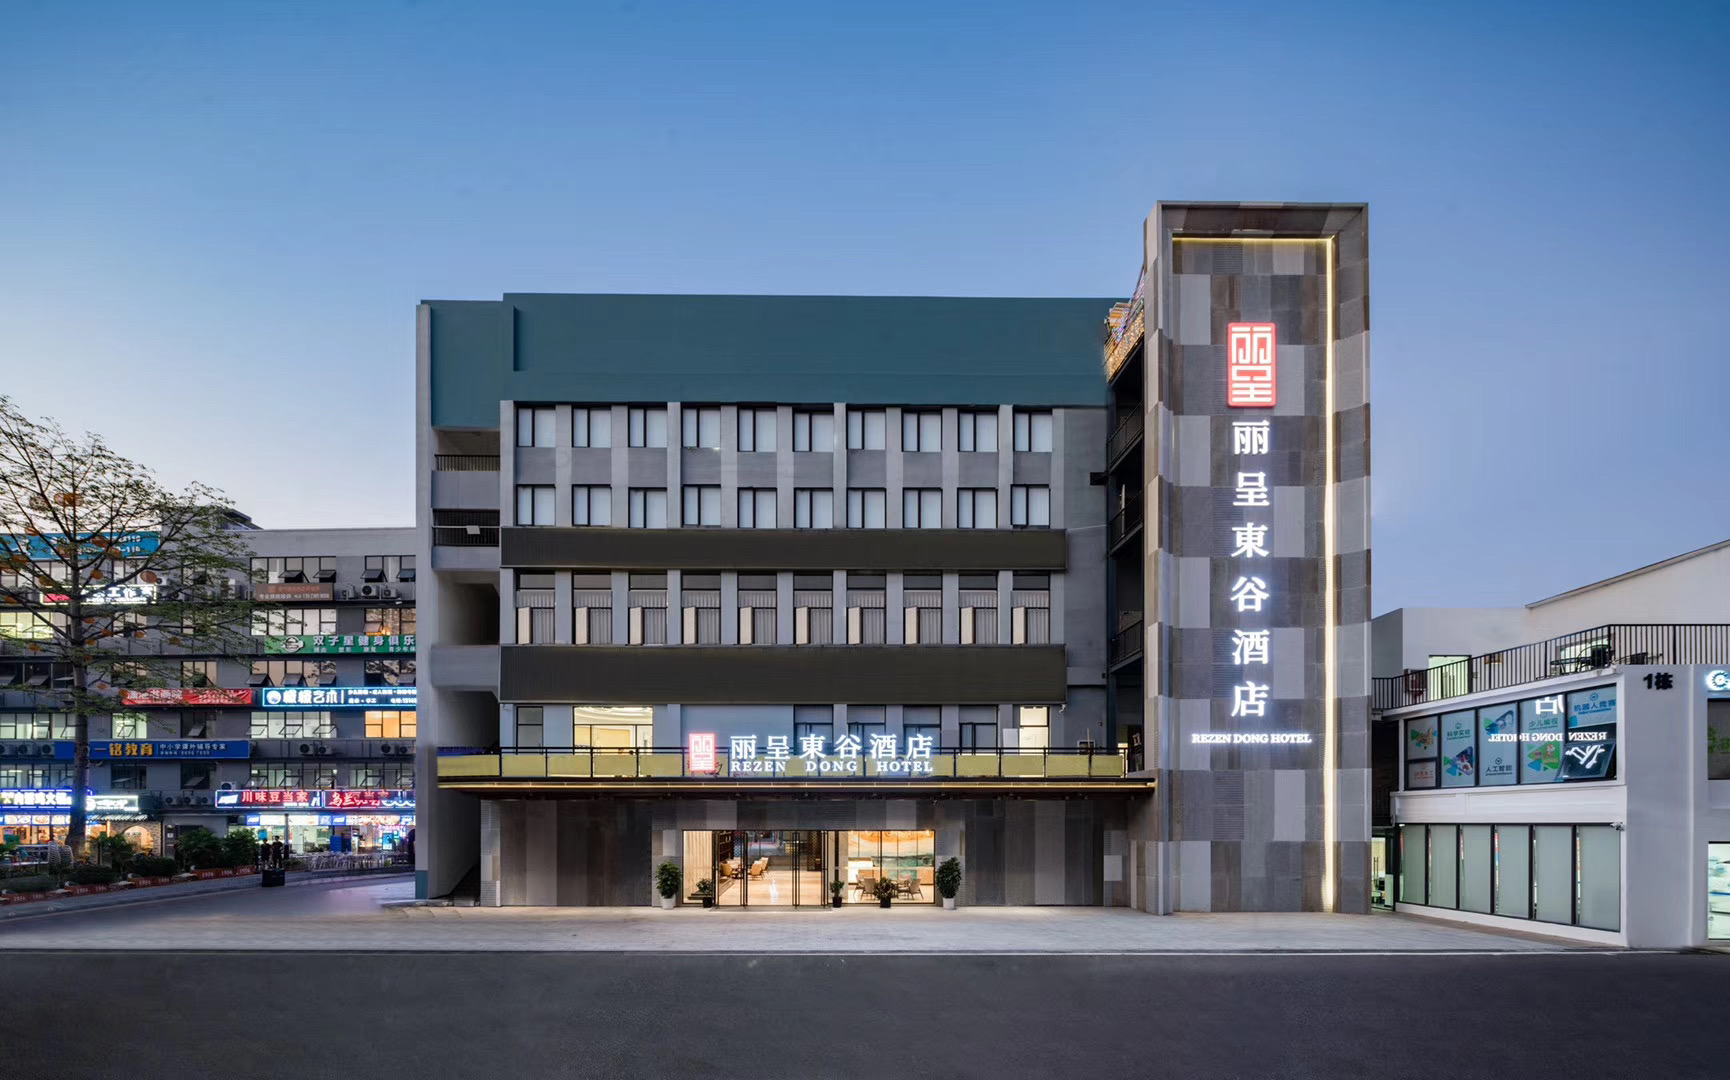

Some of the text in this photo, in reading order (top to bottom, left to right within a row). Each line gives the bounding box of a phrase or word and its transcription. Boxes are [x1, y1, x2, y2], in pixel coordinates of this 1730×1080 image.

[1230, 420, 1270, 717] 丽呈東谷酒店
[1191, 733, 1312, 743] REZEN DONG HOTEL
[730, 734, 933, 760] 丽呈東谷酒店
[731, 761, 933, 772] REZEN DONG HOTEL
[242, 791, 308, 803] 川味豆当家
